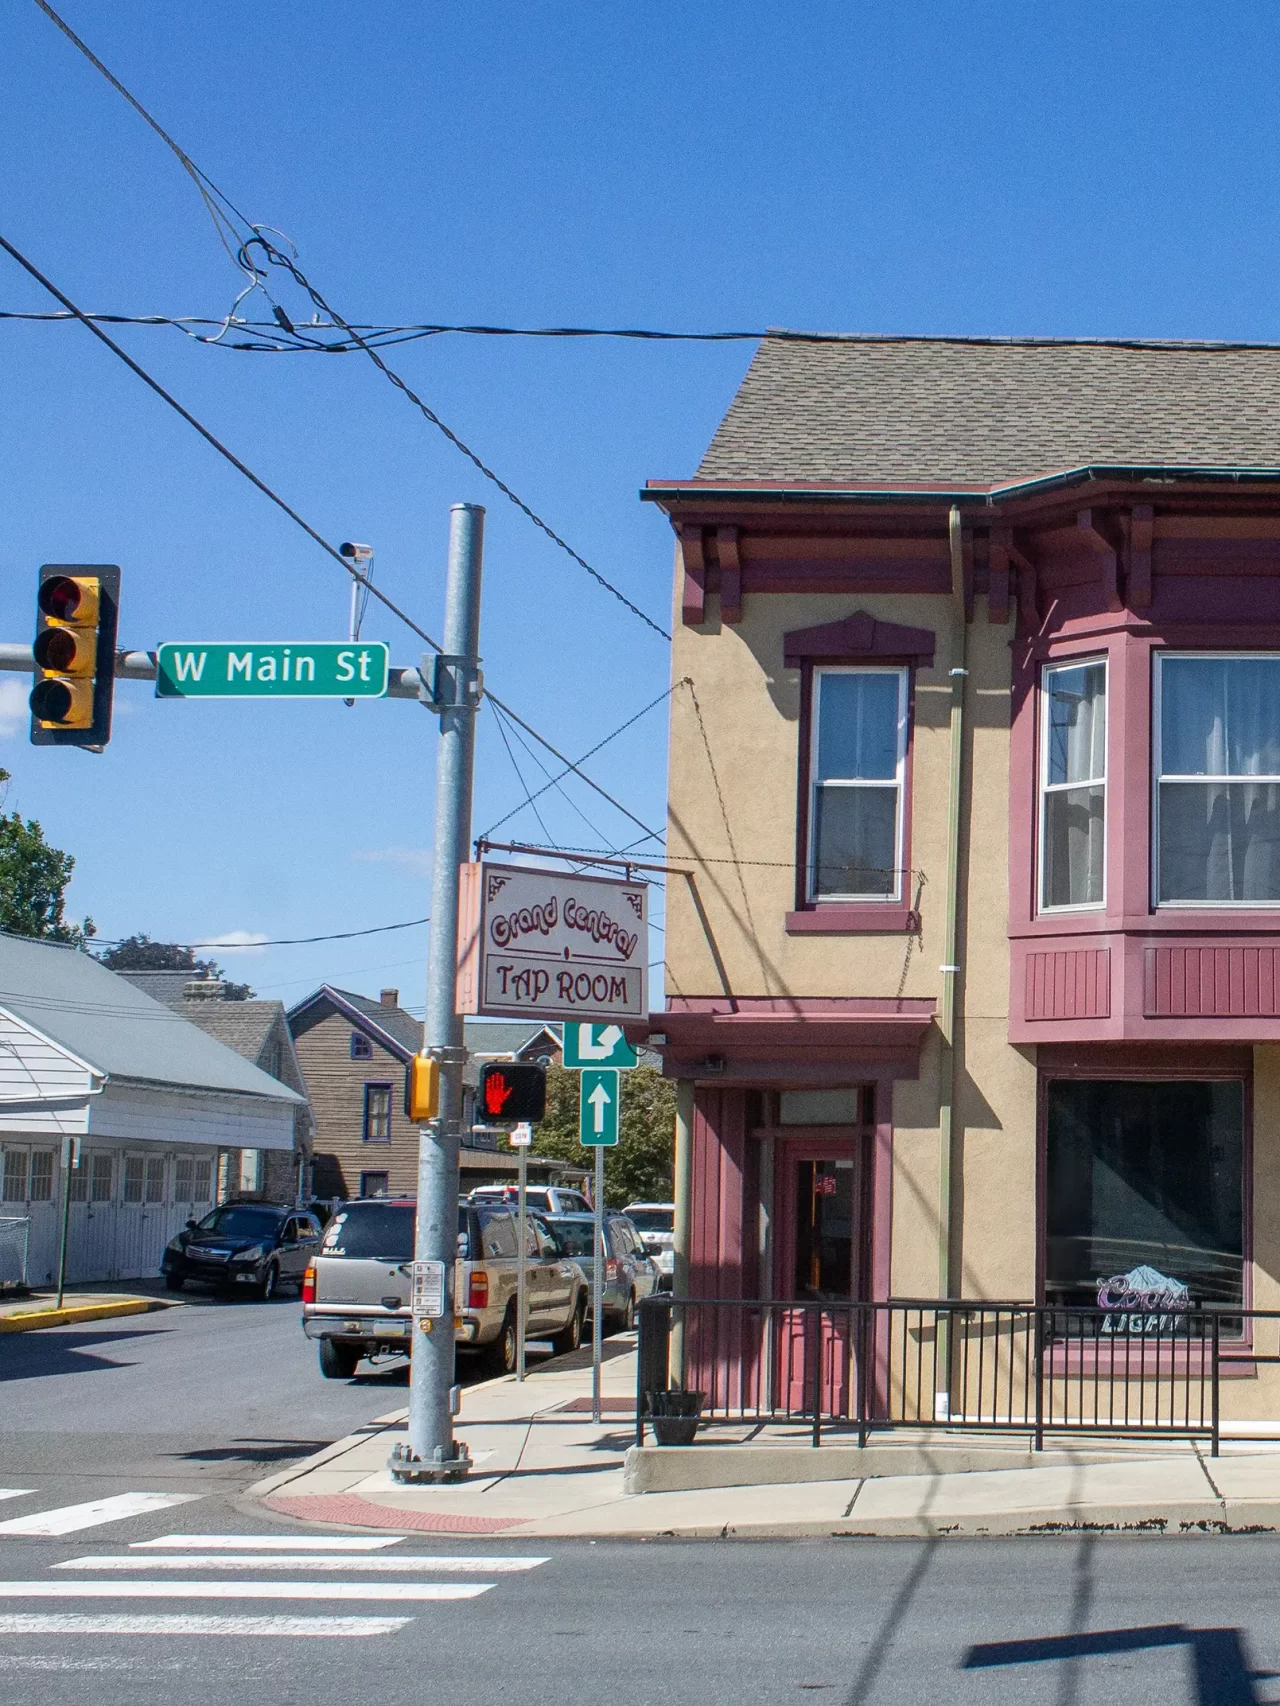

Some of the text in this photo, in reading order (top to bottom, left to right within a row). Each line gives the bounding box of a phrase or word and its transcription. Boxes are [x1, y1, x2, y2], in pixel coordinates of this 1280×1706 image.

[173, 648, 372, 682] W Main St
[490, 895, 639, 960] Grand Central
[496, 965, 629, 1004] TAP ROOM
[1096, 1274, 1191, 1310] Coors
[1100, 1313, 1185, 1333] LIGHT
